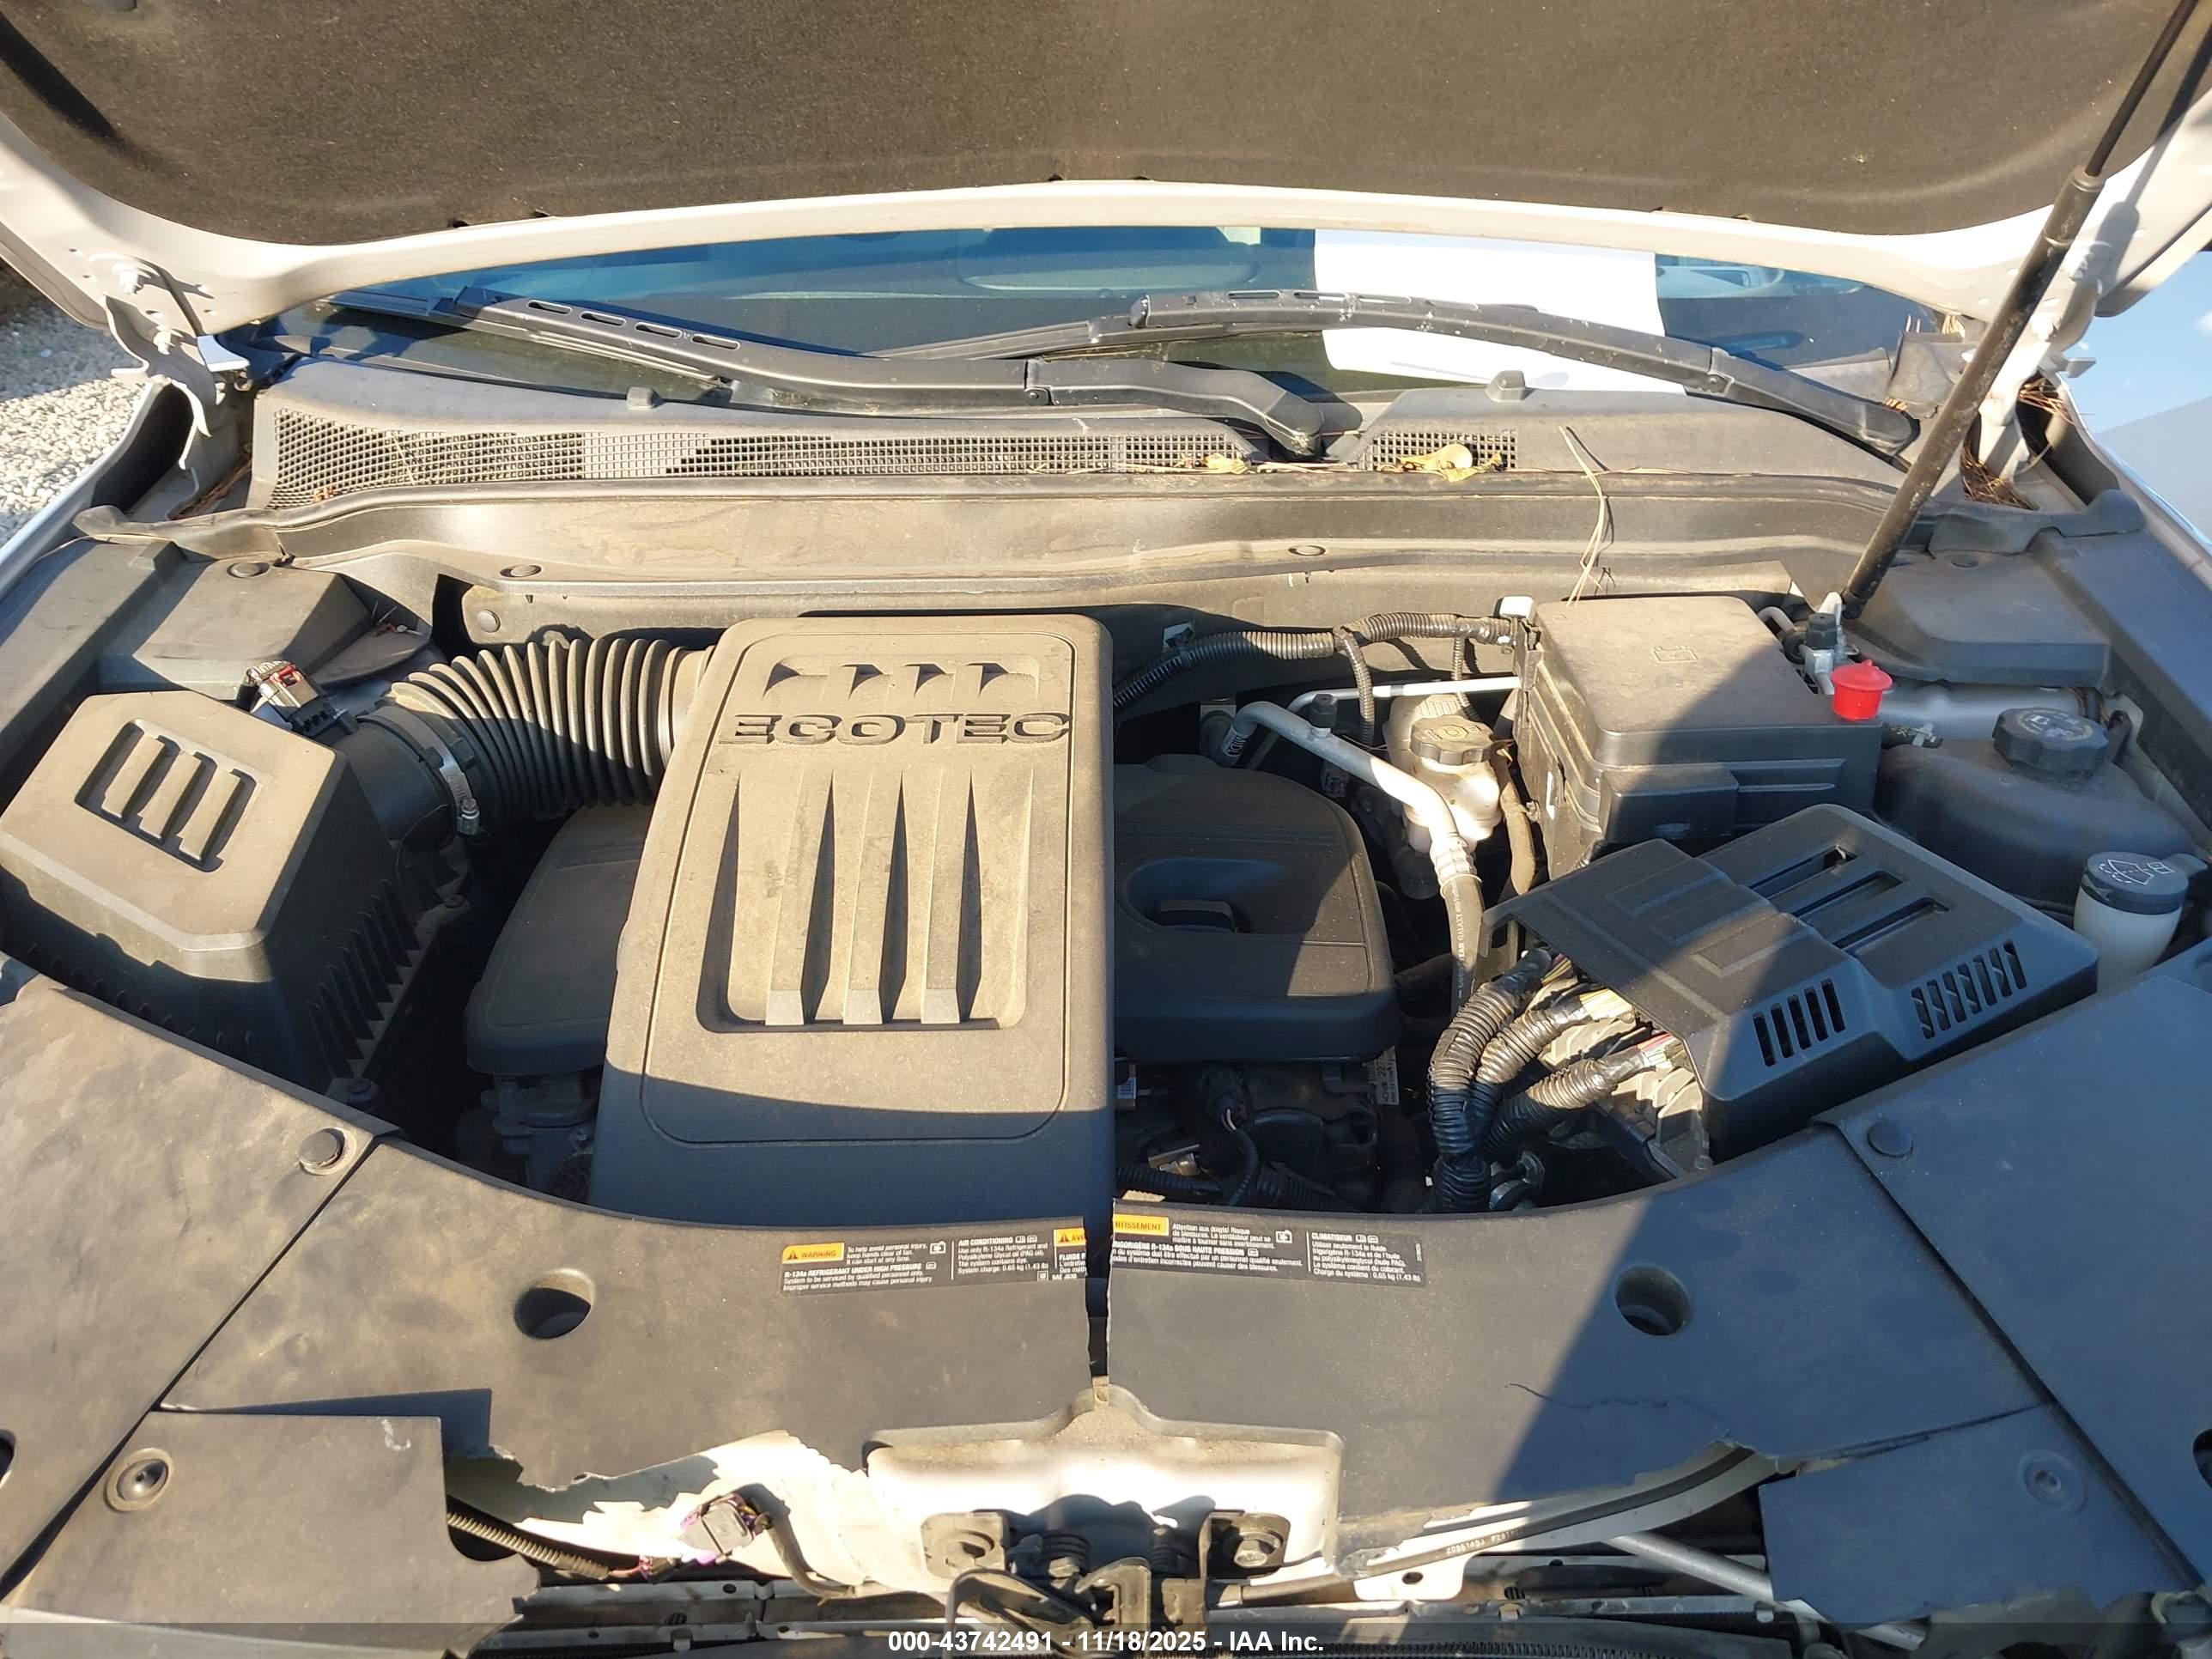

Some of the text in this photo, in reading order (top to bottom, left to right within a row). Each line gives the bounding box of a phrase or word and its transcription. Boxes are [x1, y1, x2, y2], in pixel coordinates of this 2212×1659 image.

[719, 713, 1073, 745] ECOTEC
[1455, 914, 1464, 941] GALAXY
[970, 1237, 1013, 1246] CONDITIONING
[1312, 1233, 1352, 1242] CLIMATISEUR
[1151, 1243, 1173, 1252] R-134a
[1192, 1245, 1212, 1254] HAUTE
[1213, 1247, 1245, 1255] PRESSION
[808, 1267, 850, 1276] REFRIGERANT
